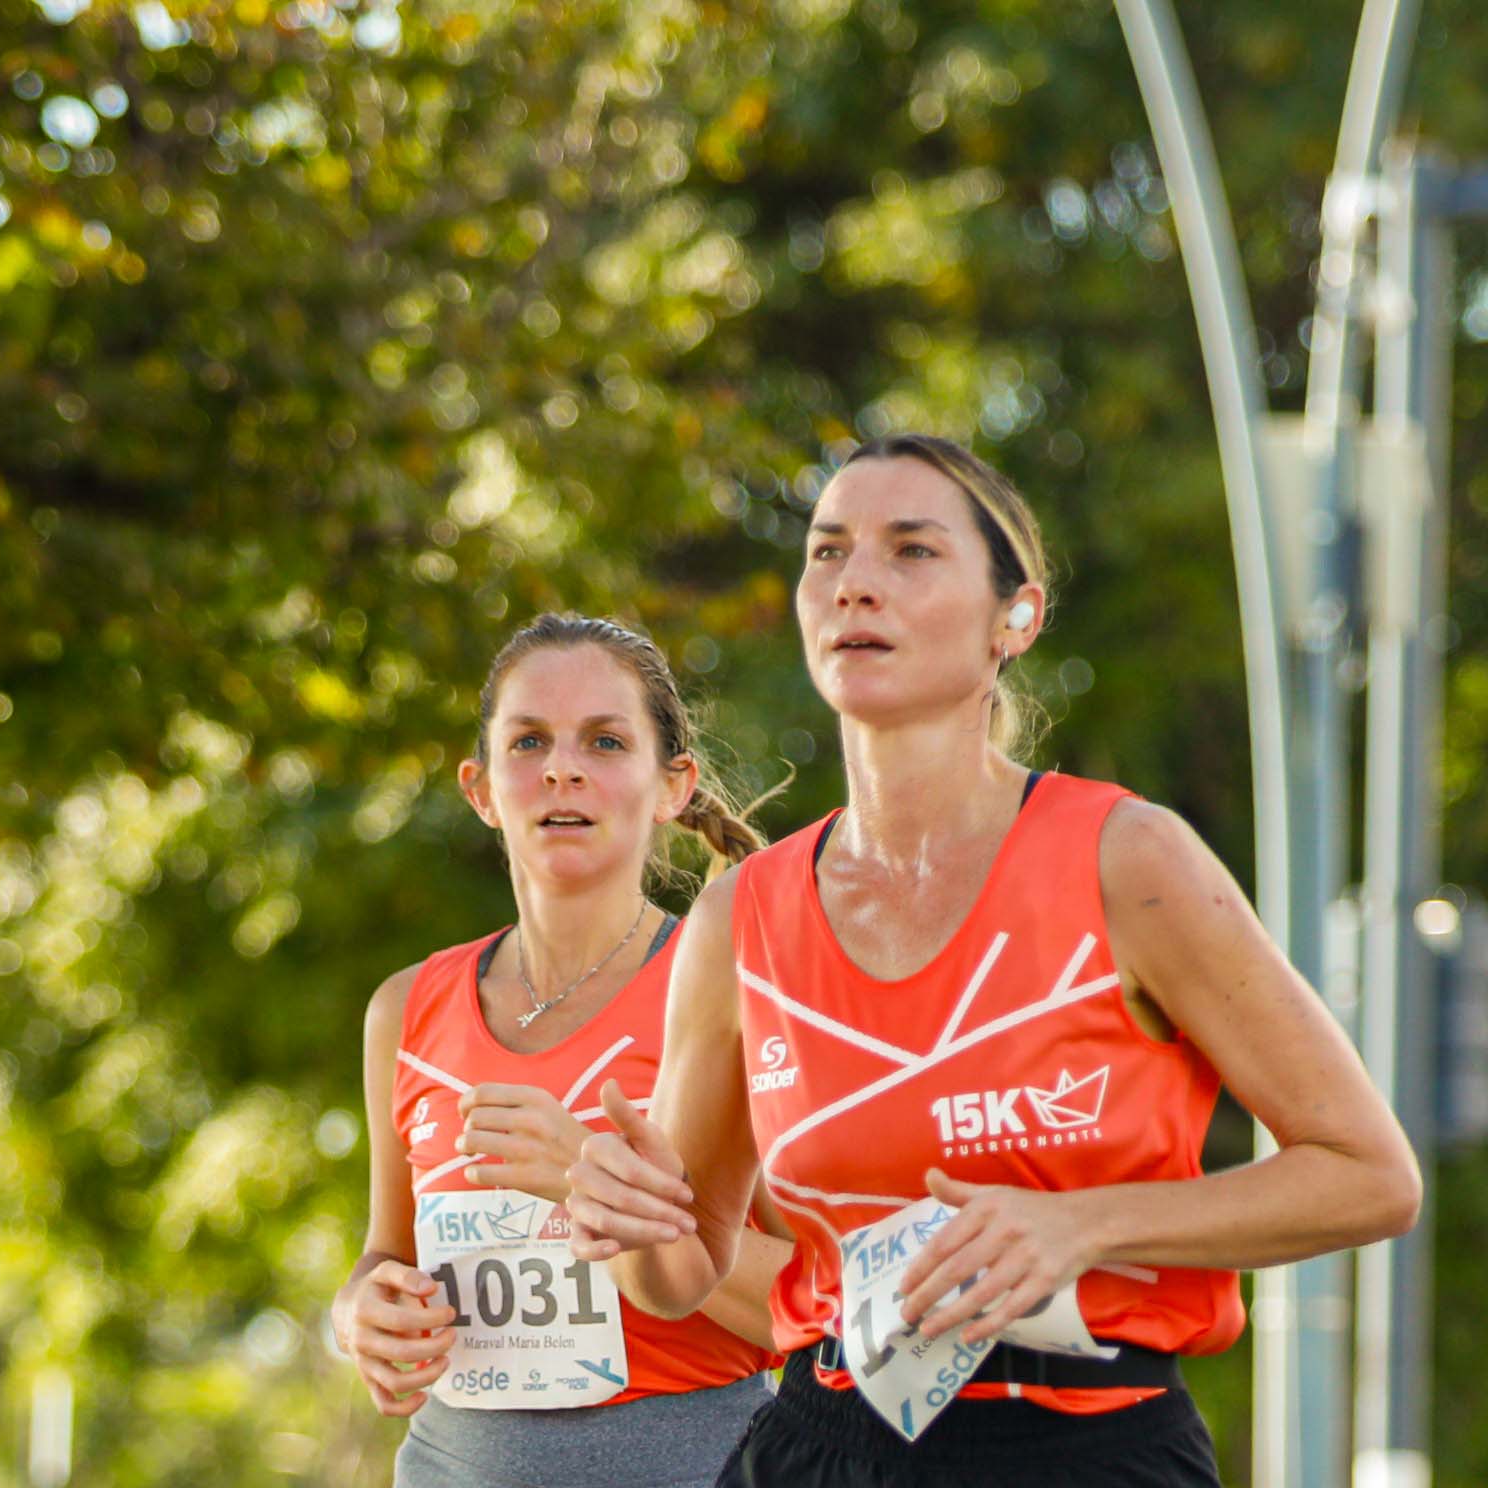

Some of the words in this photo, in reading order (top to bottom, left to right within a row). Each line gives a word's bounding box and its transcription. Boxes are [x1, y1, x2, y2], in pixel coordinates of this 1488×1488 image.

[930, 1087, 1027, 1142] 15K
[943, 1139, 1029, 1158] PUERTO
[1037, 1127, 1102, 1147] NORTE
[433, 1211, 483, 1242] 15K
[855, 1226, 907, 1279] 15K
[430, 1257, 607, 1328] 1031
[509, 1335, 540, 1349] Maria
[543, 1335, 575, 1349] Belen
[451, 1366, 510, 1391] osde
